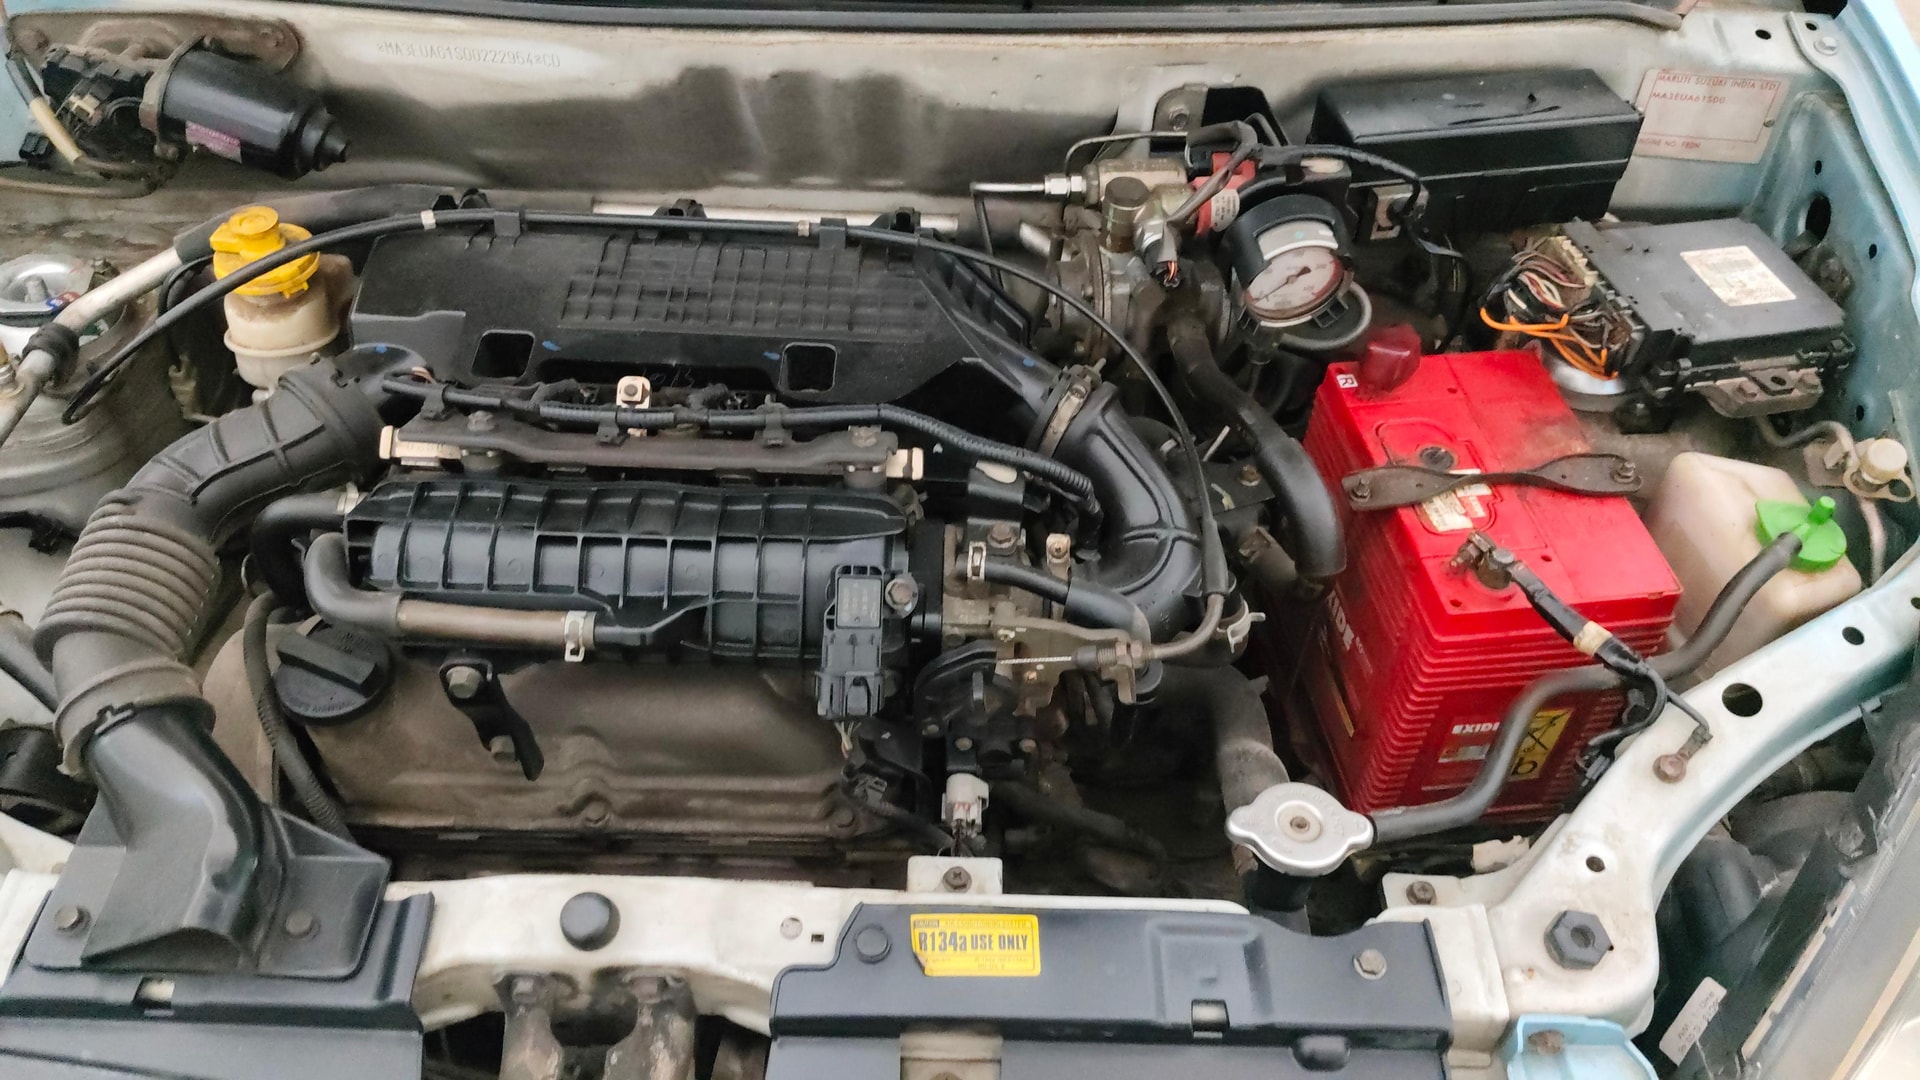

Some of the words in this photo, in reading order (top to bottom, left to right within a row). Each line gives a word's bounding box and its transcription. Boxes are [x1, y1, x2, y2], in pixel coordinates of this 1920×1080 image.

[1657, 73, 1691, 84] MARUTI
[1694, 77, 1727, 87] SUZUKI
[1729, 79, 1756, 89] INDIA
[919, 931, 967, 952] R134a
[971, 935, 993, 951] USE
[998, 935, 1028, 951] ONLY
